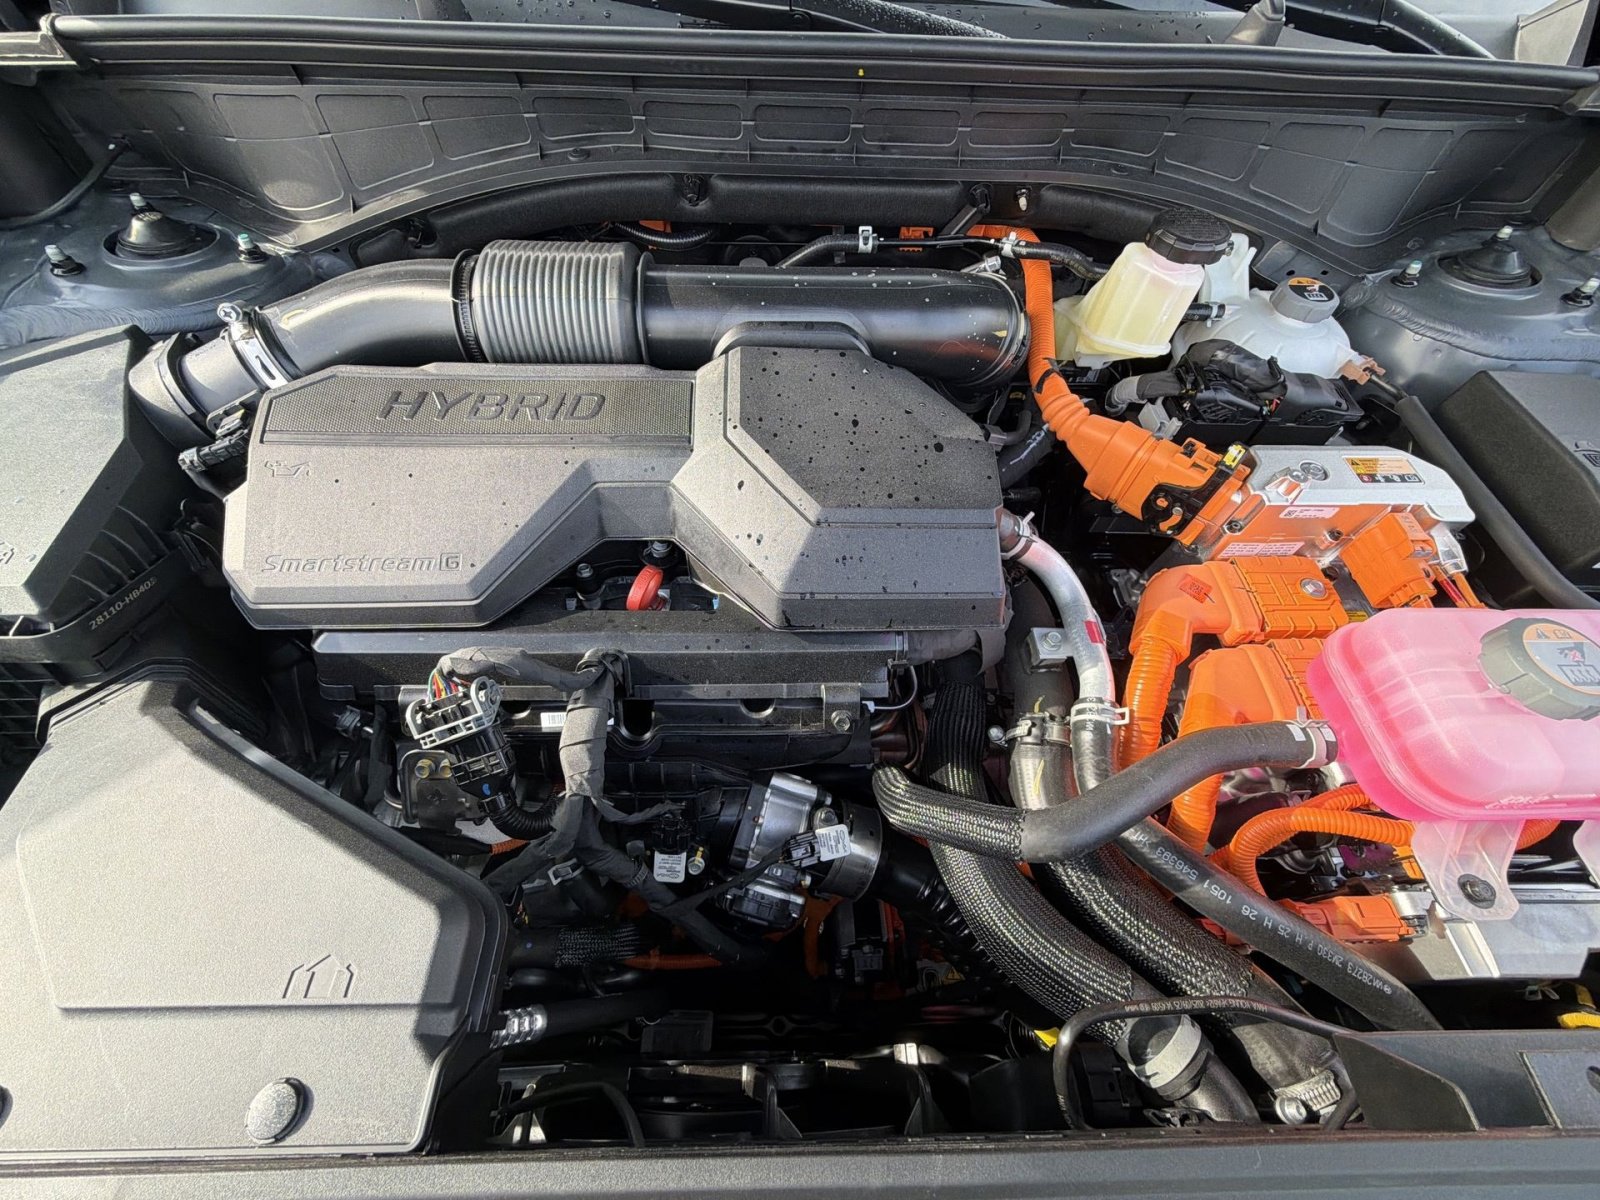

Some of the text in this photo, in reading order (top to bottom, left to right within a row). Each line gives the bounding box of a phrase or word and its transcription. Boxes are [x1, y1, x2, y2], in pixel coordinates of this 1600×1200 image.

[376, 390, 606, 421] HYBRID
[261, 554, 435, 573] Smartstream
[1203, 879, 1232, 904] 1051
[1241, 905, 1258, 920] 26
[1277, 924, 1291, 938] 25
